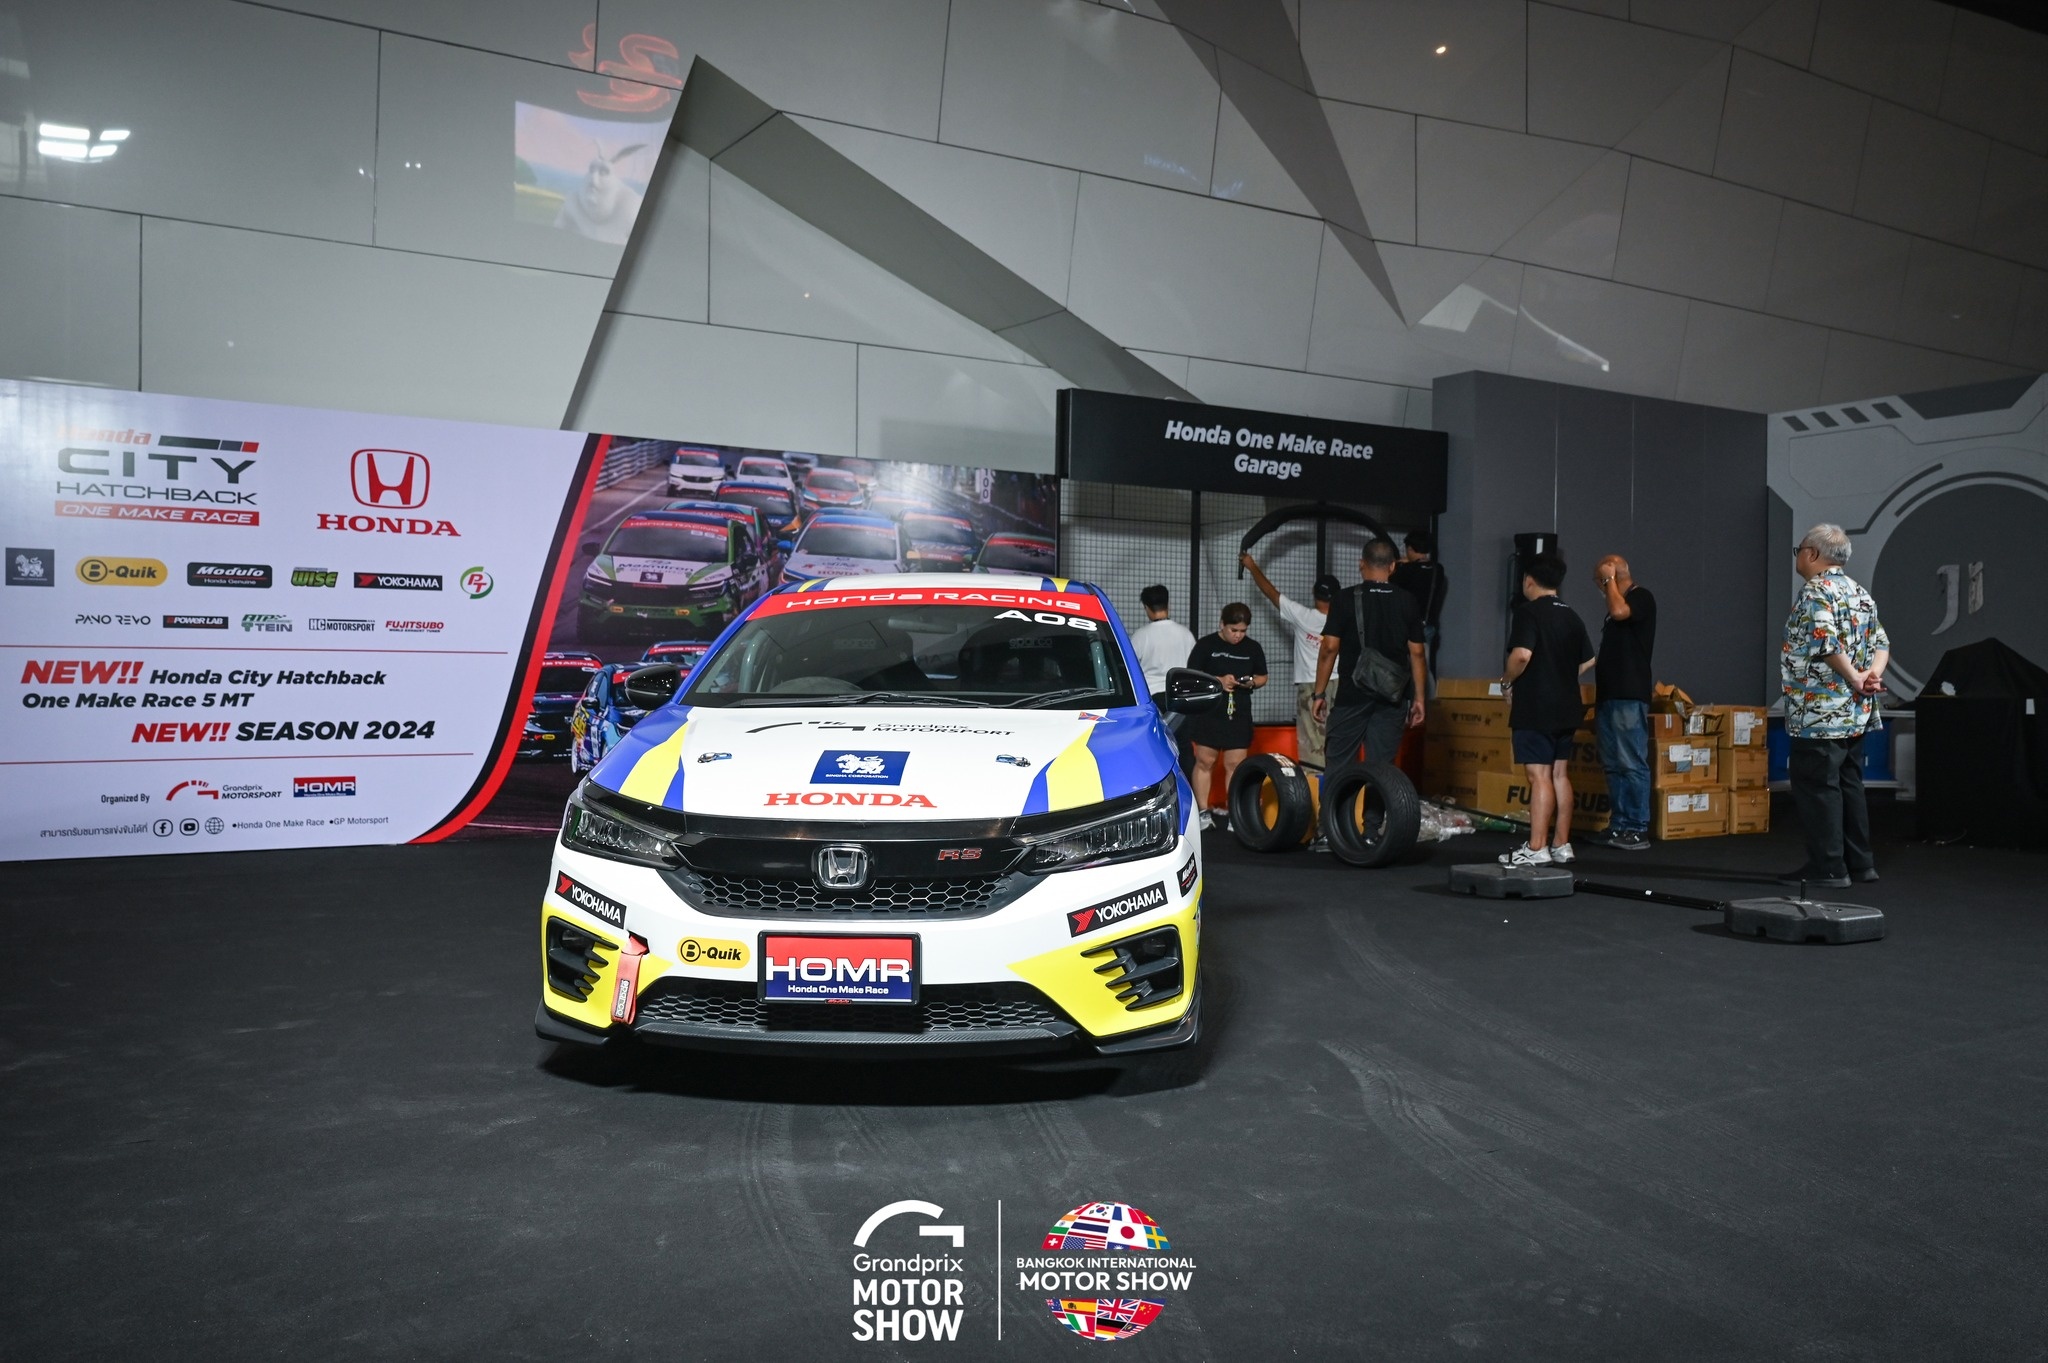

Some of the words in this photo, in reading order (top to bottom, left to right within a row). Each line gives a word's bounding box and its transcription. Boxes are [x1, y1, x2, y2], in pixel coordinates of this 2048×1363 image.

[1165, 420, 1231, 446] Honda
[1236, 428, 1273, 450] One
[1277, 433, 1326, 455] Make
[1329, 438, 1373, 460] Race
[58, 447, 256, 484] CITY
[1234, 454, 1301, 480] Garage
[57, 481, 257, 505] HATCHBACK
[62, 504, 111, 517] ONE
[118, 507, 185, 520] MAKE
[191, 510, 253, 524] RACE
[316, 513, 461, 537] HONDA
[81, 560, 157, 582] B-Quik
[197, 566, 265, 577] Modulo
[377, 576, 439, 588] YOKOHAMA
[785, 593, 923, 608] Honda
[933, 592, 1081, 611] RACING
[75, 614, 112, 625] PANO
[116, 614, 151, 626] REVO
[255, 623, 293, 632] TEIN
[327, 622, 375, 632] MOTORSPORT
[385, 620, 445, 630] FUJITSUBO
[994, 609, 1097, 631] A08
[20, 659, 144, 685] NEW!!
[149, 669, 220, 686] Honda
[228, 669, 274, 688] City
[277, 670, 386, 686] Hatchback
[22, 693, 70, 709] One
[75, 693, 137, 708] Make
[141, 693, 196, 708] Race
[201, 693, 216, 707] 5
[219, 693, 254, 707] MT
[131, 722, 231, 744] NEW!!
[235, 721, 359, 742] SEASON
[363, 720, 435, 740] 2024
[872, 727, 1015, 736] MOTORSPORT
[222, 784, 263, 793] Grandprix
[222, 791, 282, 799] MOTORSPORT
[294, 782, 355, 793] HOMR
[101, 794, 139, 805] Organized
[140, 793, 150, 803] By
[763, 792, 938, 809] HONDA
[265, 820, 281, 828] One
[283, 819, 304, 828] Make
[306, 818, 325, 827] Race
[347, 817, 389, 826] Motorsport
[938, 848, 983, 861] RS
[571, 883, 622, 924] YOKOHAMA
[1095, 888, 1164, 923] YOKOHAMA
[680, 940, 742, 962] B-Quik
[765, 957, 910, 983] HOMR
[616, 980, 630, 1016] sparco
[788, 985, 817, 993] Honda
[819, 985, 838, 993] One
[839, 986, 864, 994] Make
[865, 986, 889, 994] Race
